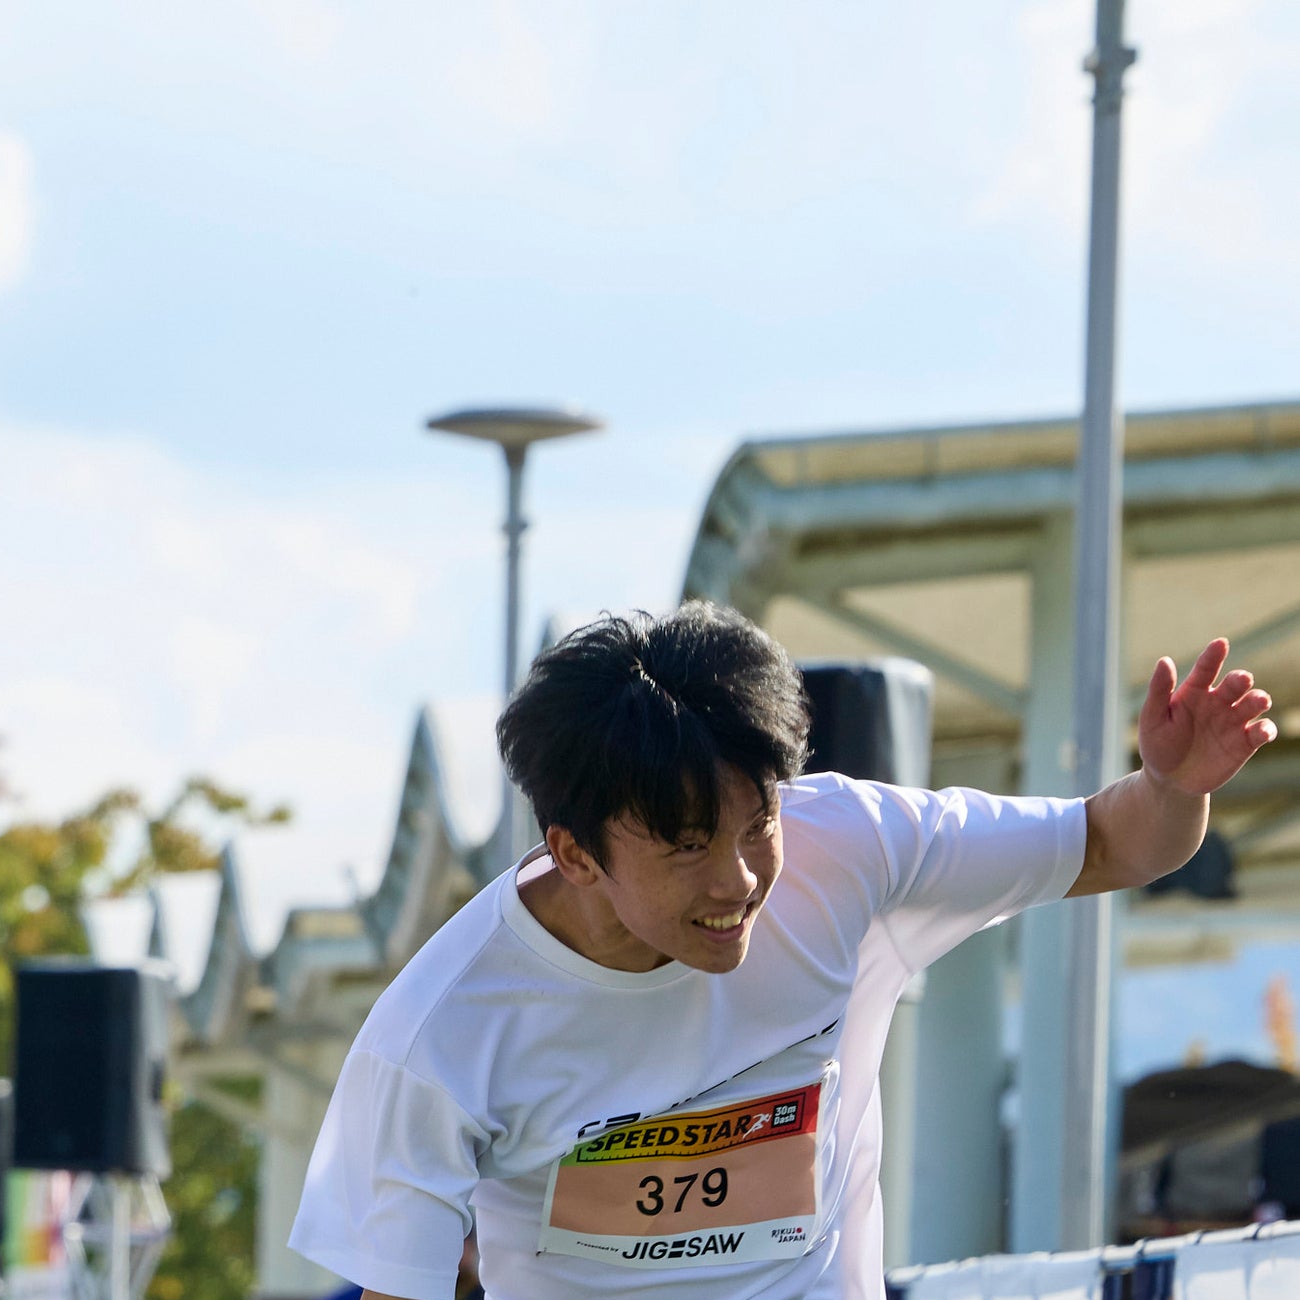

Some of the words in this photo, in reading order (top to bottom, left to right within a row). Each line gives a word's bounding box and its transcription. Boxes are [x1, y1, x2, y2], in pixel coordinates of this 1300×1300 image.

[775, 1104, 797, 1117] 30m
[773, 1114, 796, 1126] Dash
[635, 1166, 729, 1217] 379
[778, 1232, 806, 1243] JAPAN
